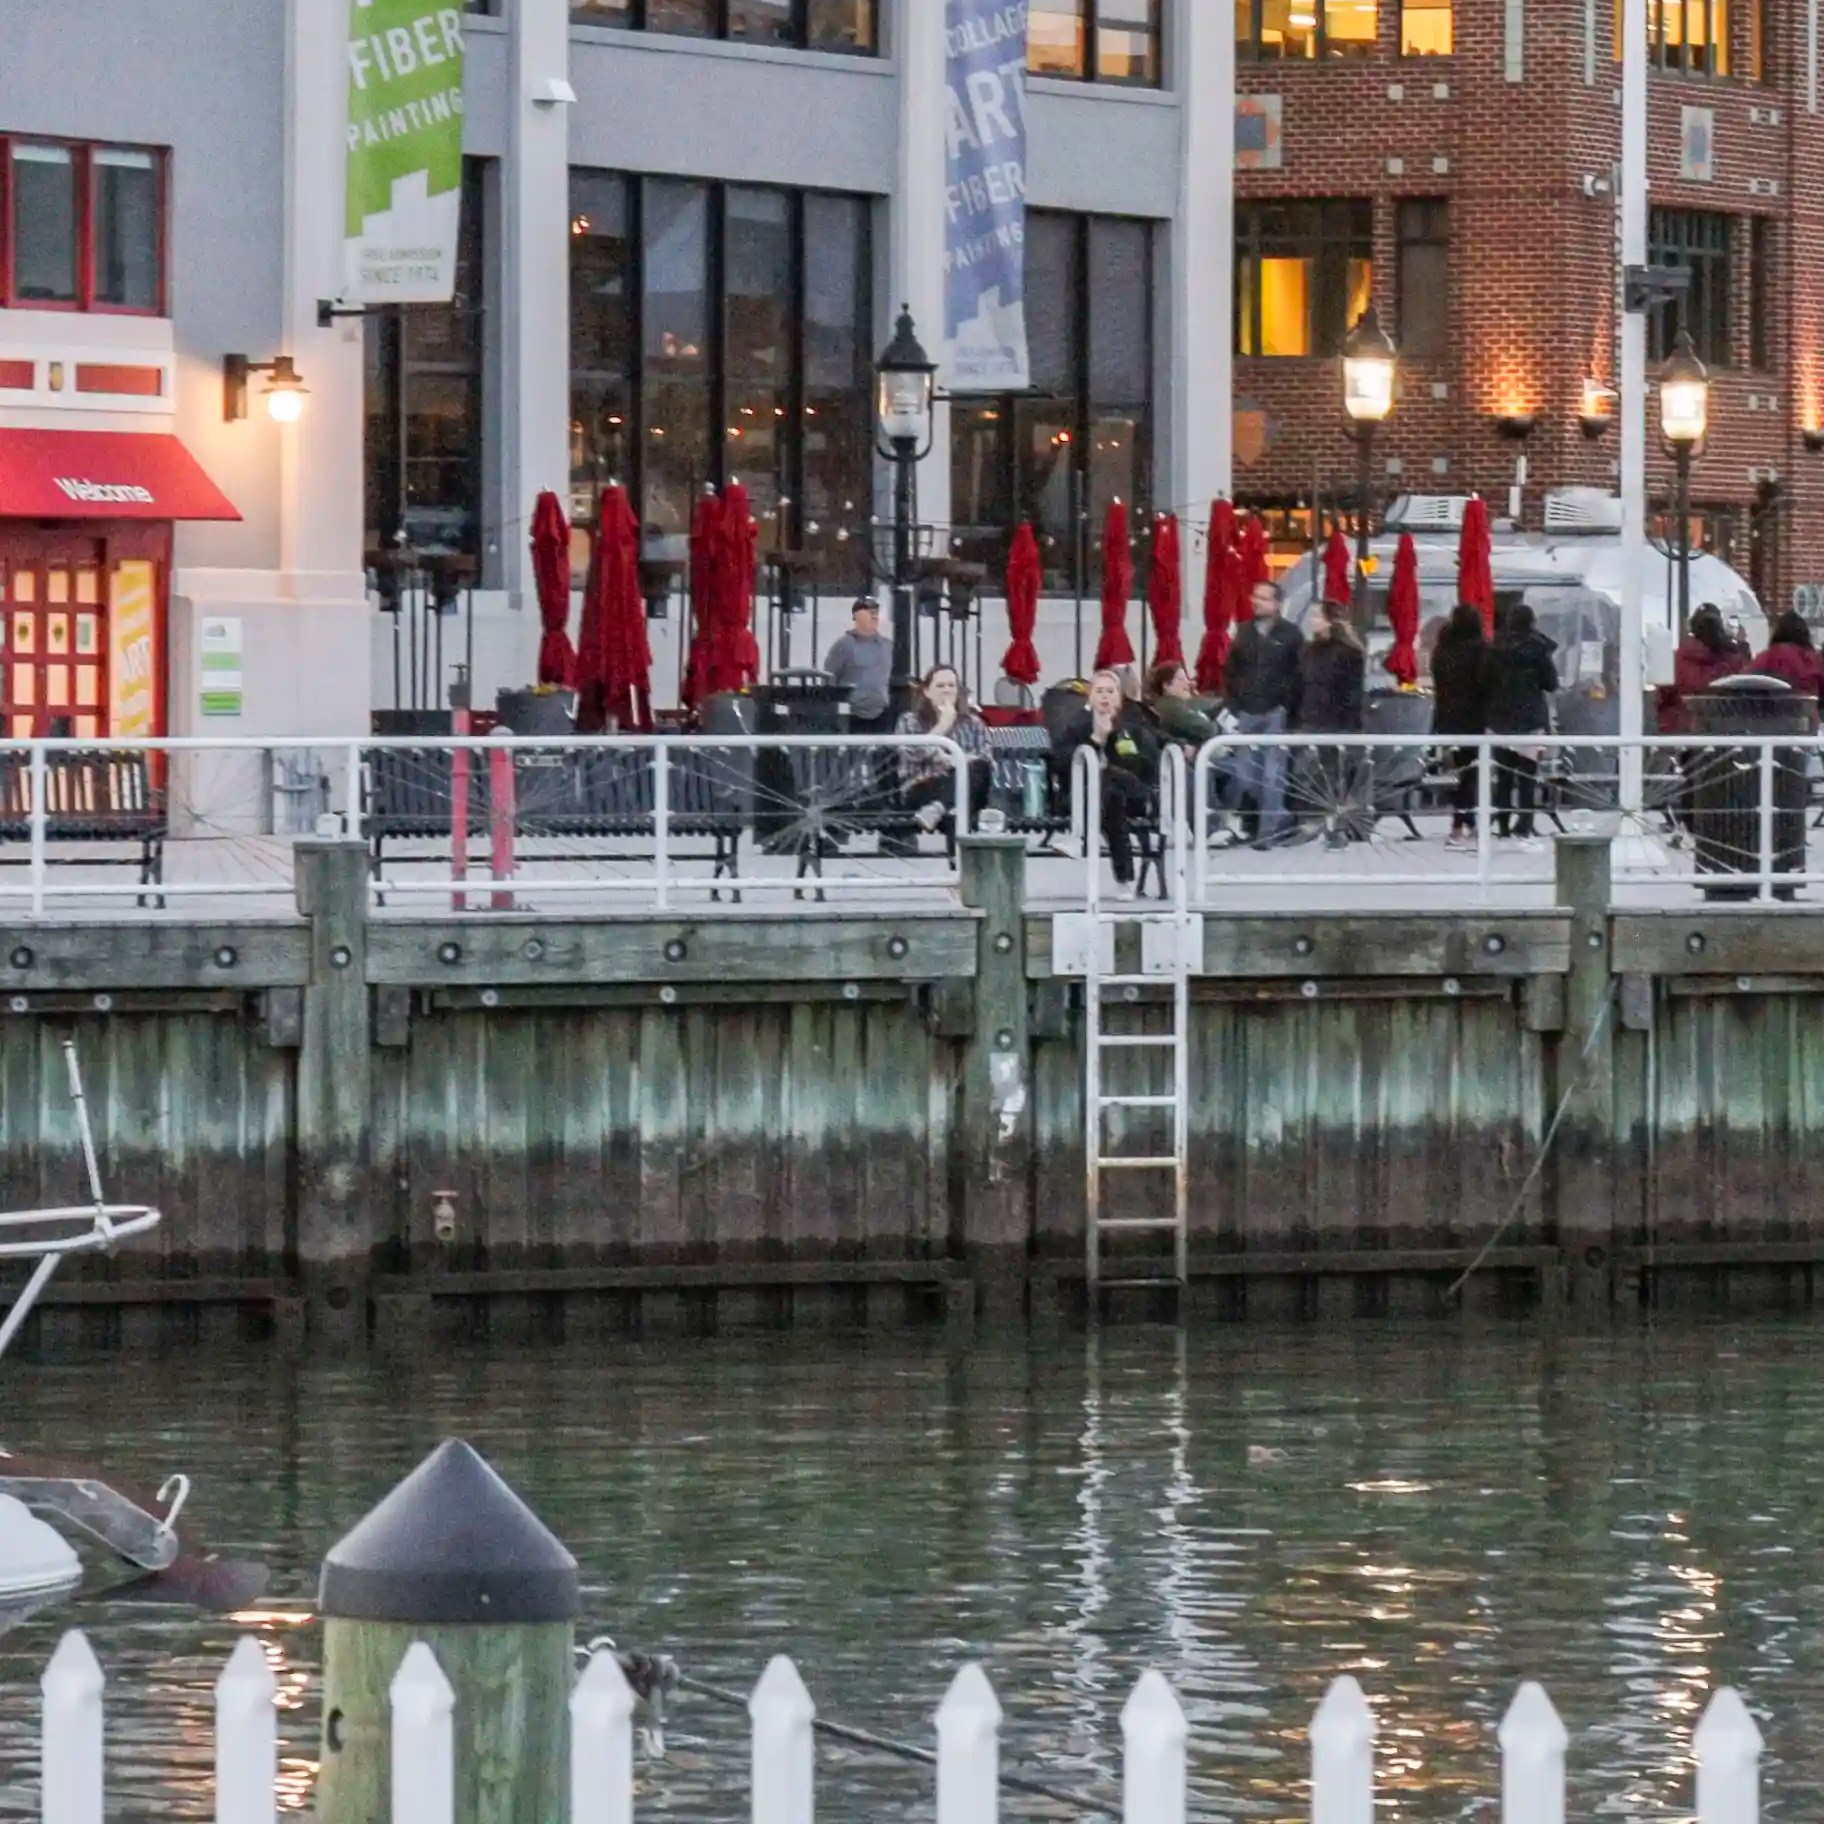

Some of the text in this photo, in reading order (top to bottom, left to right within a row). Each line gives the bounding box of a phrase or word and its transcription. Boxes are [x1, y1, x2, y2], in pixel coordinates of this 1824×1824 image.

[349, 8, 464, 90] FIBER
[347, 87, 462, 151] PAINTING
[944, 59, 1024, 160] ART
[943, 161, 1024, 223] FIBER
[941, 221, 1023, 274] PAINTNG
[52, 477, 155, 504] Welcome
